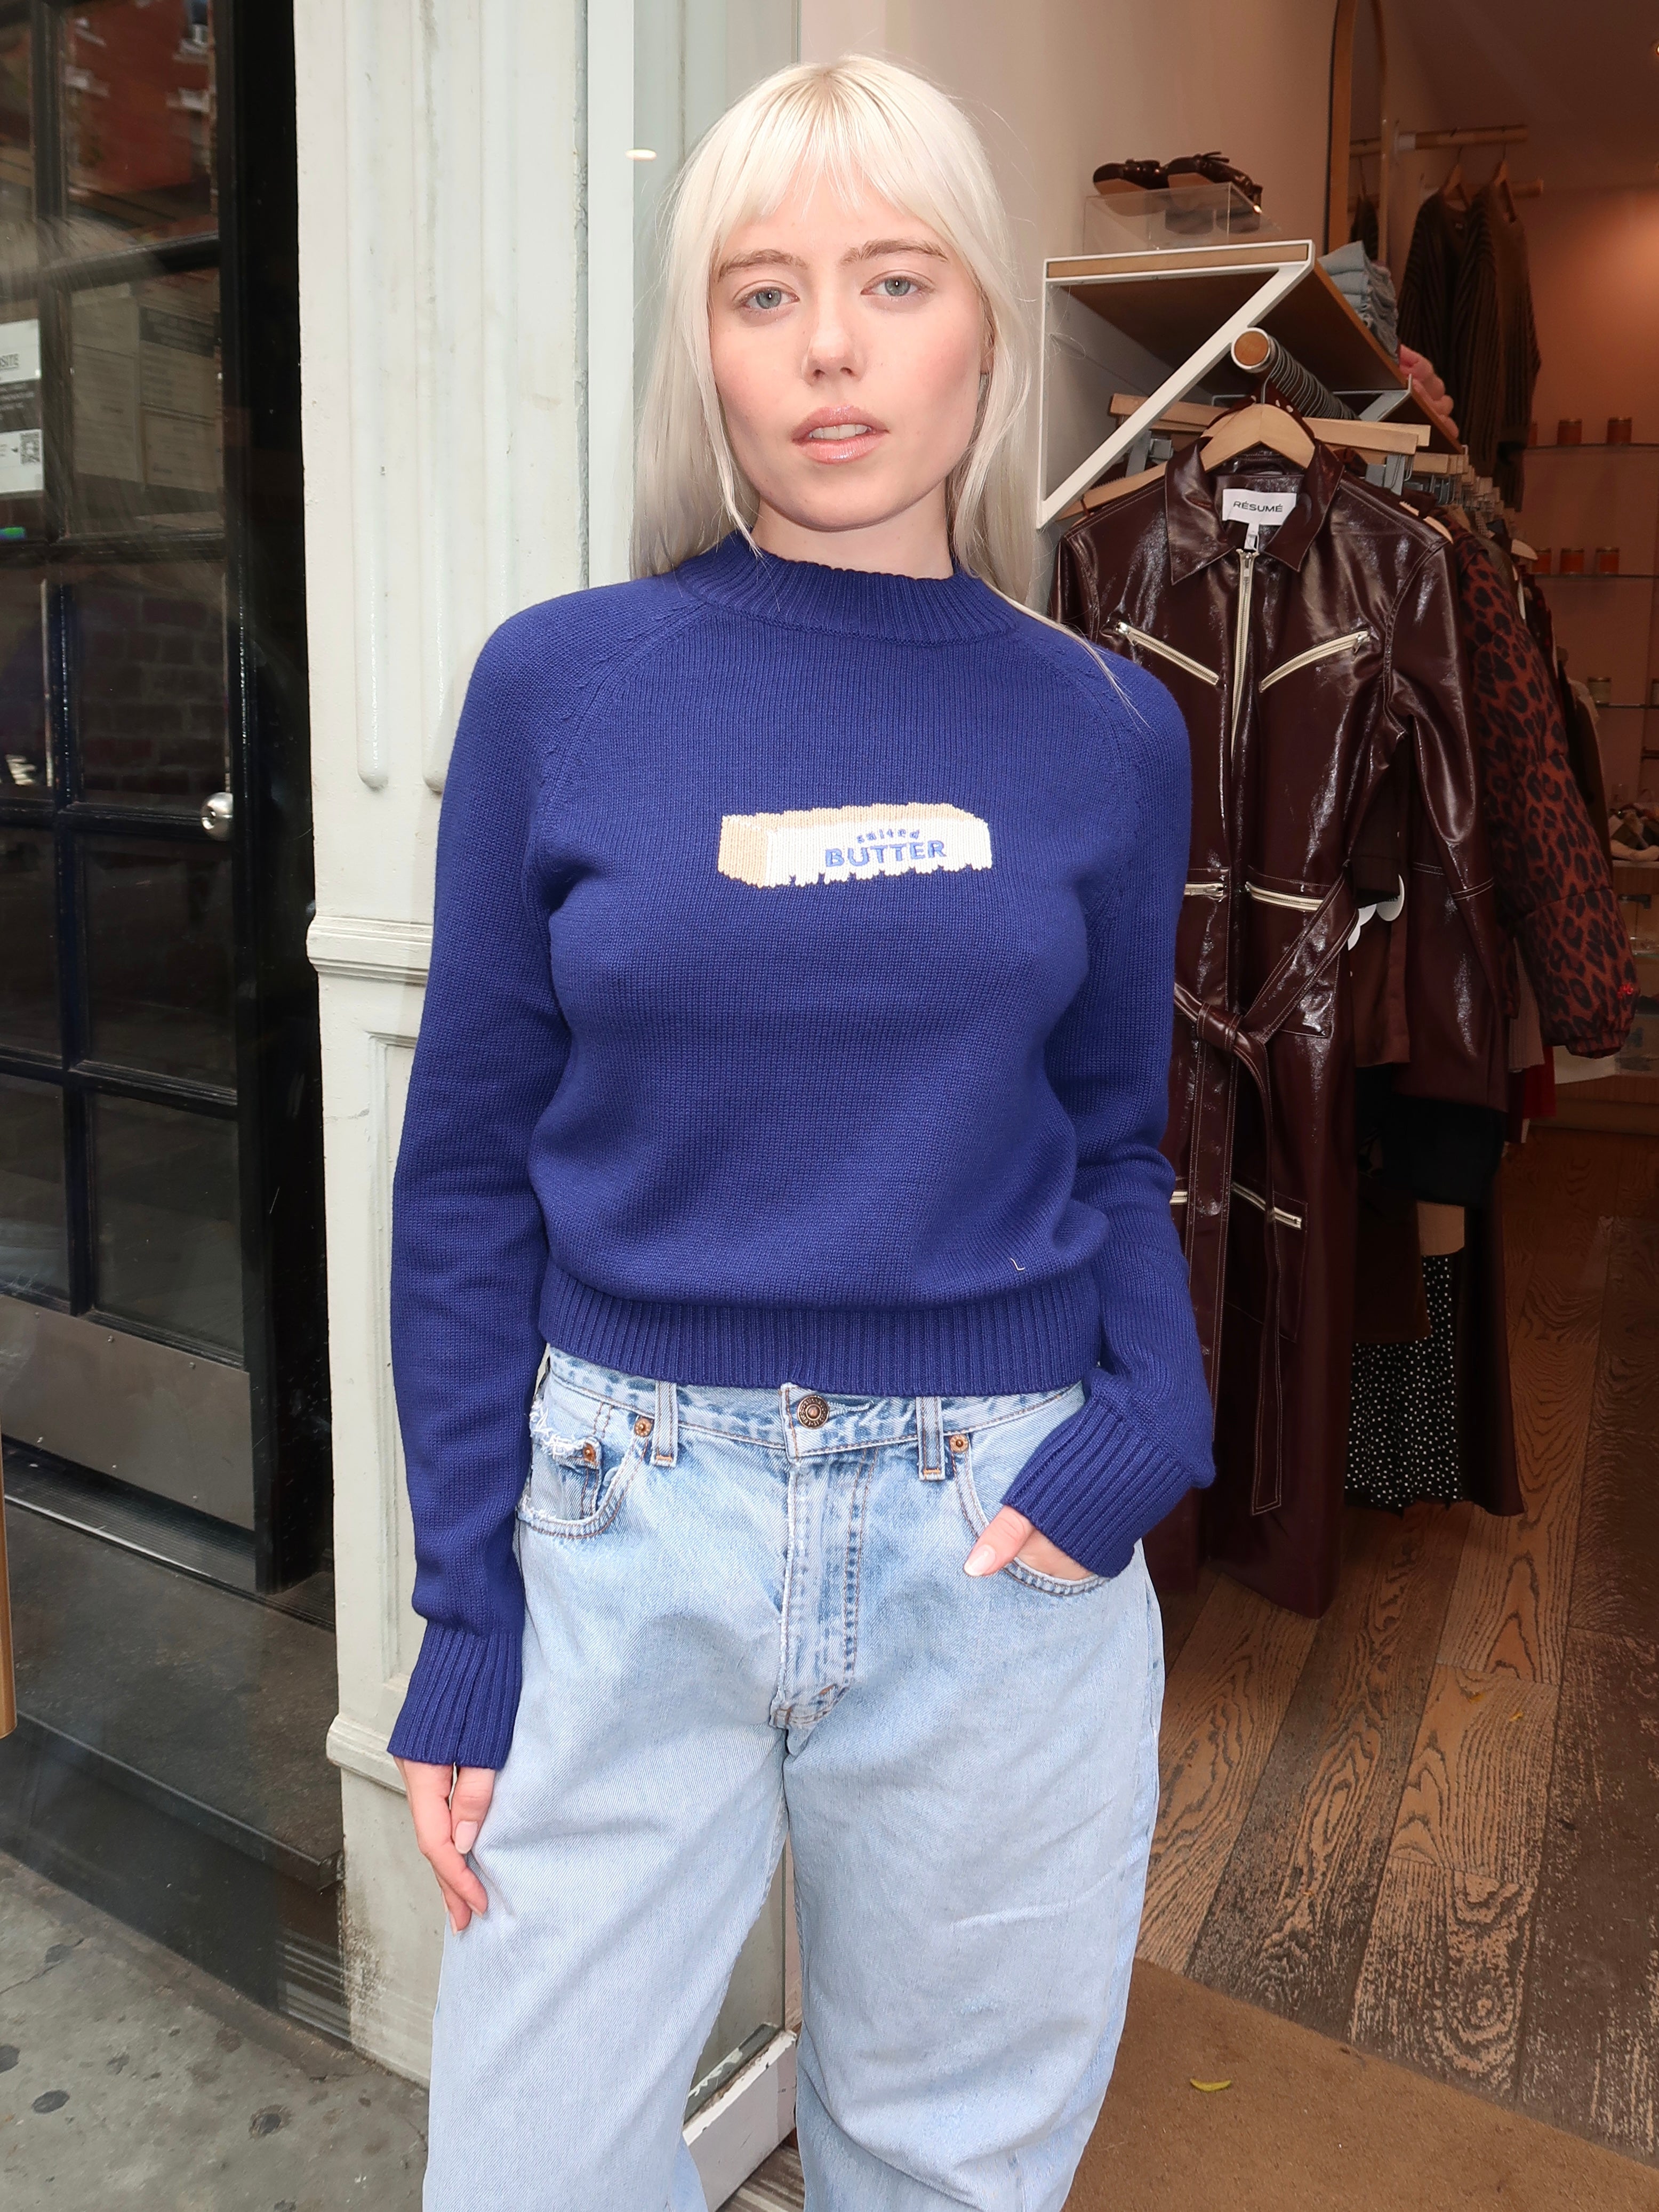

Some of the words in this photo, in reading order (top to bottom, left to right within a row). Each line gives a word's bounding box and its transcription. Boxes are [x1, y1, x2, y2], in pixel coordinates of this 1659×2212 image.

[1233, 501, 1283, 512] RÉSUMÉ
[856, 829, 919, 844] salted
[826, 840, 947, 867] BUTTER
